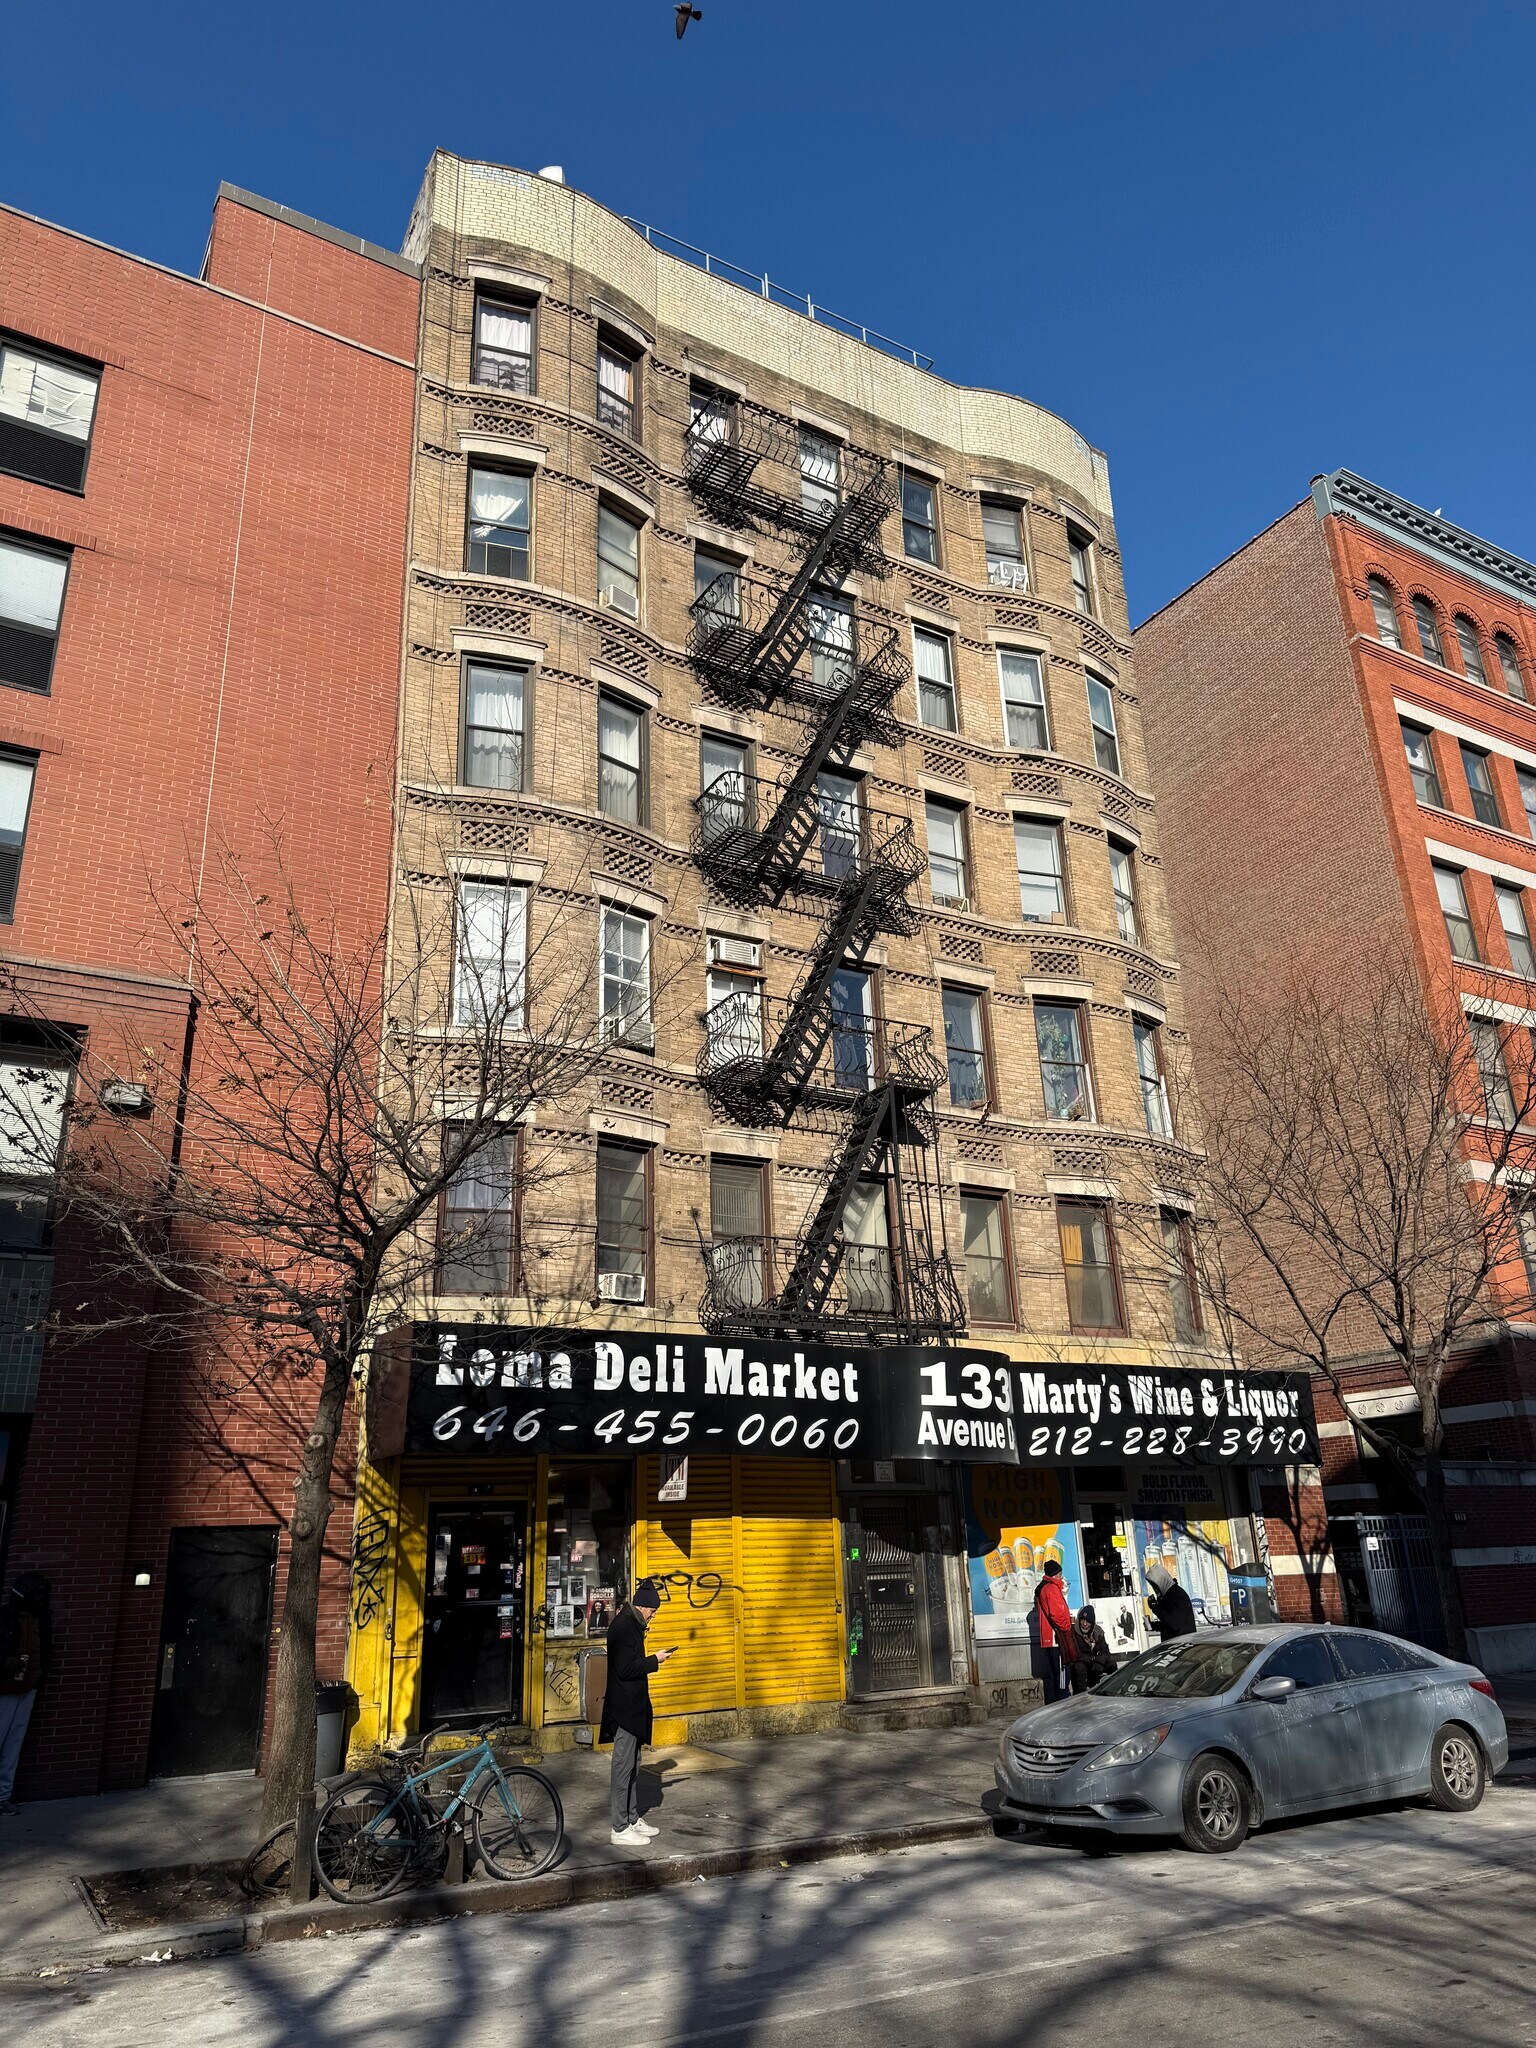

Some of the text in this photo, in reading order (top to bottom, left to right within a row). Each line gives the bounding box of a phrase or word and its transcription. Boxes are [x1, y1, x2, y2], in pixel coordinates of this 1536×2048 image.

[436, 1334, 859, 1403] Loma Deli Market
[919, 1361, 1011, 1413] 133
[1019, 1371, 1299, 1427] Marty's Wine & Liquor
[917, 1411, 1006, 1449] Avenue
[986, 1469, 1046, 1492] HIGH
[1141, 1474, 1208, 1488] BOLD FLAVOR.
[1138, 1488, 1216, 1503] SMOOTH FINISH.
[983, 1496, 1054, 1520] NOON
[463, 1553, 482, 1564] EBT
[1238, 1588, 1246, 1604] P
